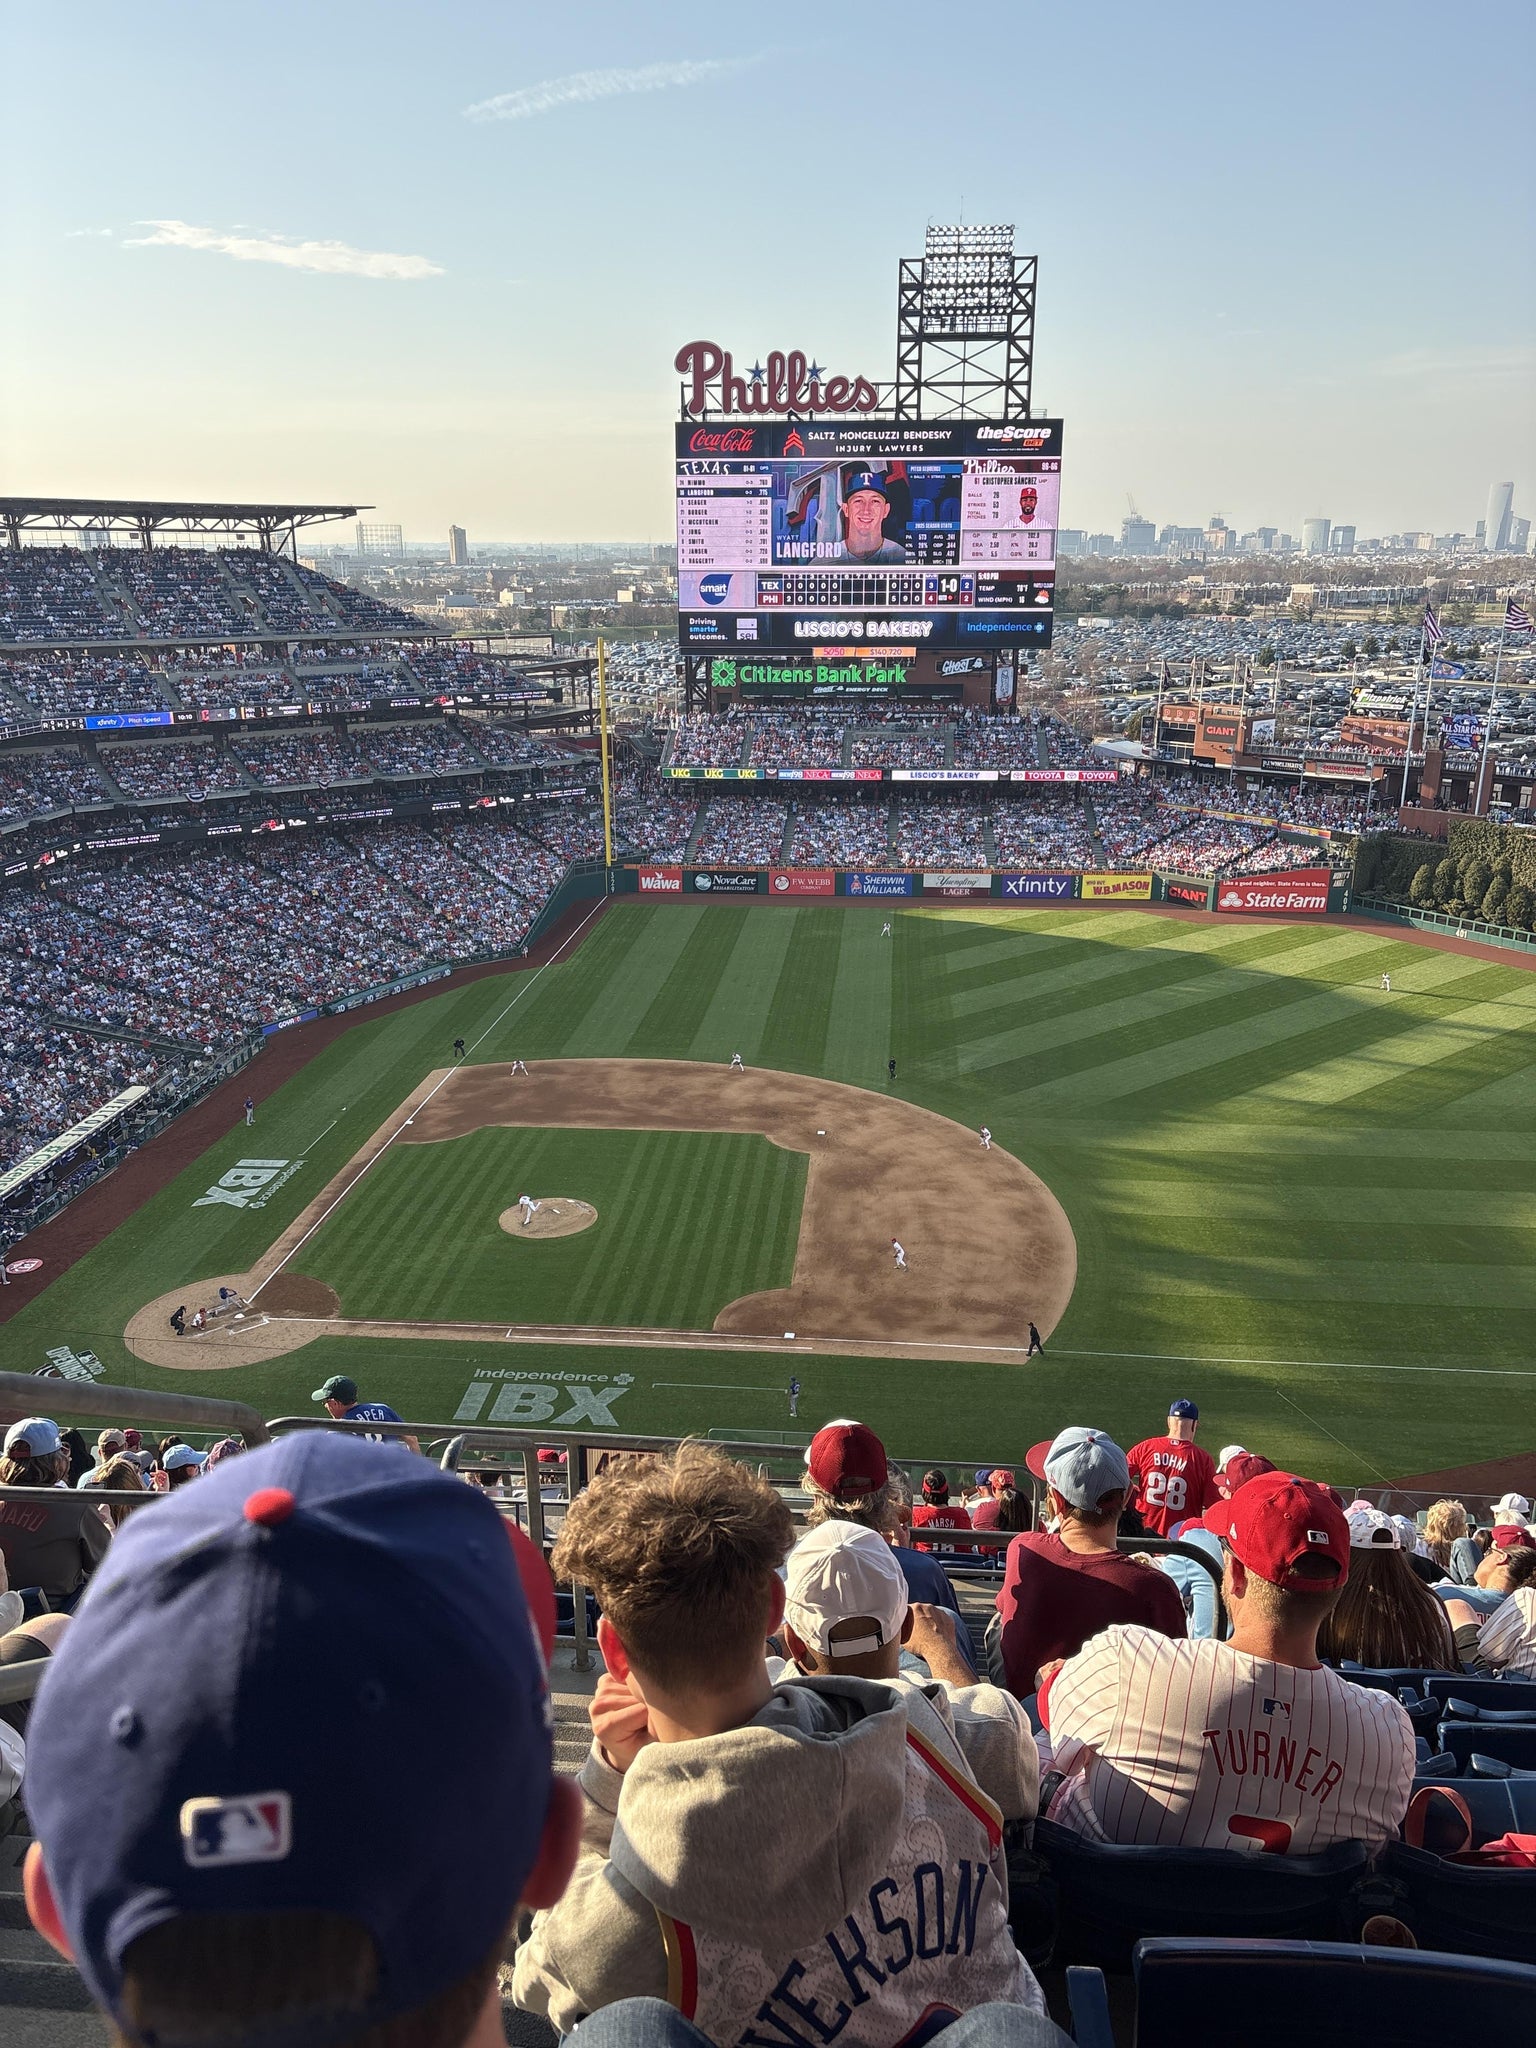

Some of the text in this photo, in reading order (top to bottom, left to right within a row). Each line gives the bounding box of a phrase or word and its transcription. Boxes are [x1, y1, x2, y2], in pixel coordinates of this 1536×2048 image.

[674, 339, 878, 415] Phillies
[808, 430, 952, 440] SALTZ MONGELUZZI BENDESKY
[976, 426, 1052, 439] theScore
[835, 444, 924, 453] INJURY LAWYERS
[680, 460, 730, 476] TEXAS
[963, 459, 1015, 474] Phillies
[776, 541, 842, 558] LANGFORD
[700, 584, 727, 593] smart
[761, 581, 779, 590] TEX
[940, 578, 957, 592] 1-0
[762, 595, 778, 603] PHI
[689, 617, 717, 626] Driving
[967, 622, 1032, 633] Independence
[794, 620, 934, 638] LISCIO'S BAKERY
[941, 657, 976, 677] GHOST
[739, 664, 907, 683] Citizens Bank Park
[1206, 726, 1236, 736] GIANT
[1440, 722, 1453, 733] ALL
[1453, 723, 1470, 733] STAR
[671, 768, 757, 778] UKG UKG UKG
[806, 770, 828, 778] NECA
[856, 771, 881, 779] NECA
[910, 771, 981, 780] LISCIO'S BAKERY
[1028, 771, 1115, 780] TOYOTA TOYOTA
[207, 827, 243, 835] ESCALADE
[641, 877, 680, 890] Wawa
[712, 875, 757, 885] NovaCare
[807, 878, 831, 886] WEBB
[864, 874, 906, 884] SHERWIN
[936, 875, 979, 887] Yuengling
[1006, 876, 1067, 895] xfinity
[943, 888, 970, 896] LAGER
[1168, 886, 1208, 902] GIANT
[1455, 929, 1468, 939] 401
[190, 1159, 290, 1208] IBX
[473, 1368, 609, 1384] Independence
[452, 1382, 630, 1427] IBX
[1153, 1451, 1188, 1473] BOHM
[1145, 1471, 1188, 1511] 28
[928, 1517, 955, 1529] MARSH
[1202, 1728, 1343, 1805] TURNER
